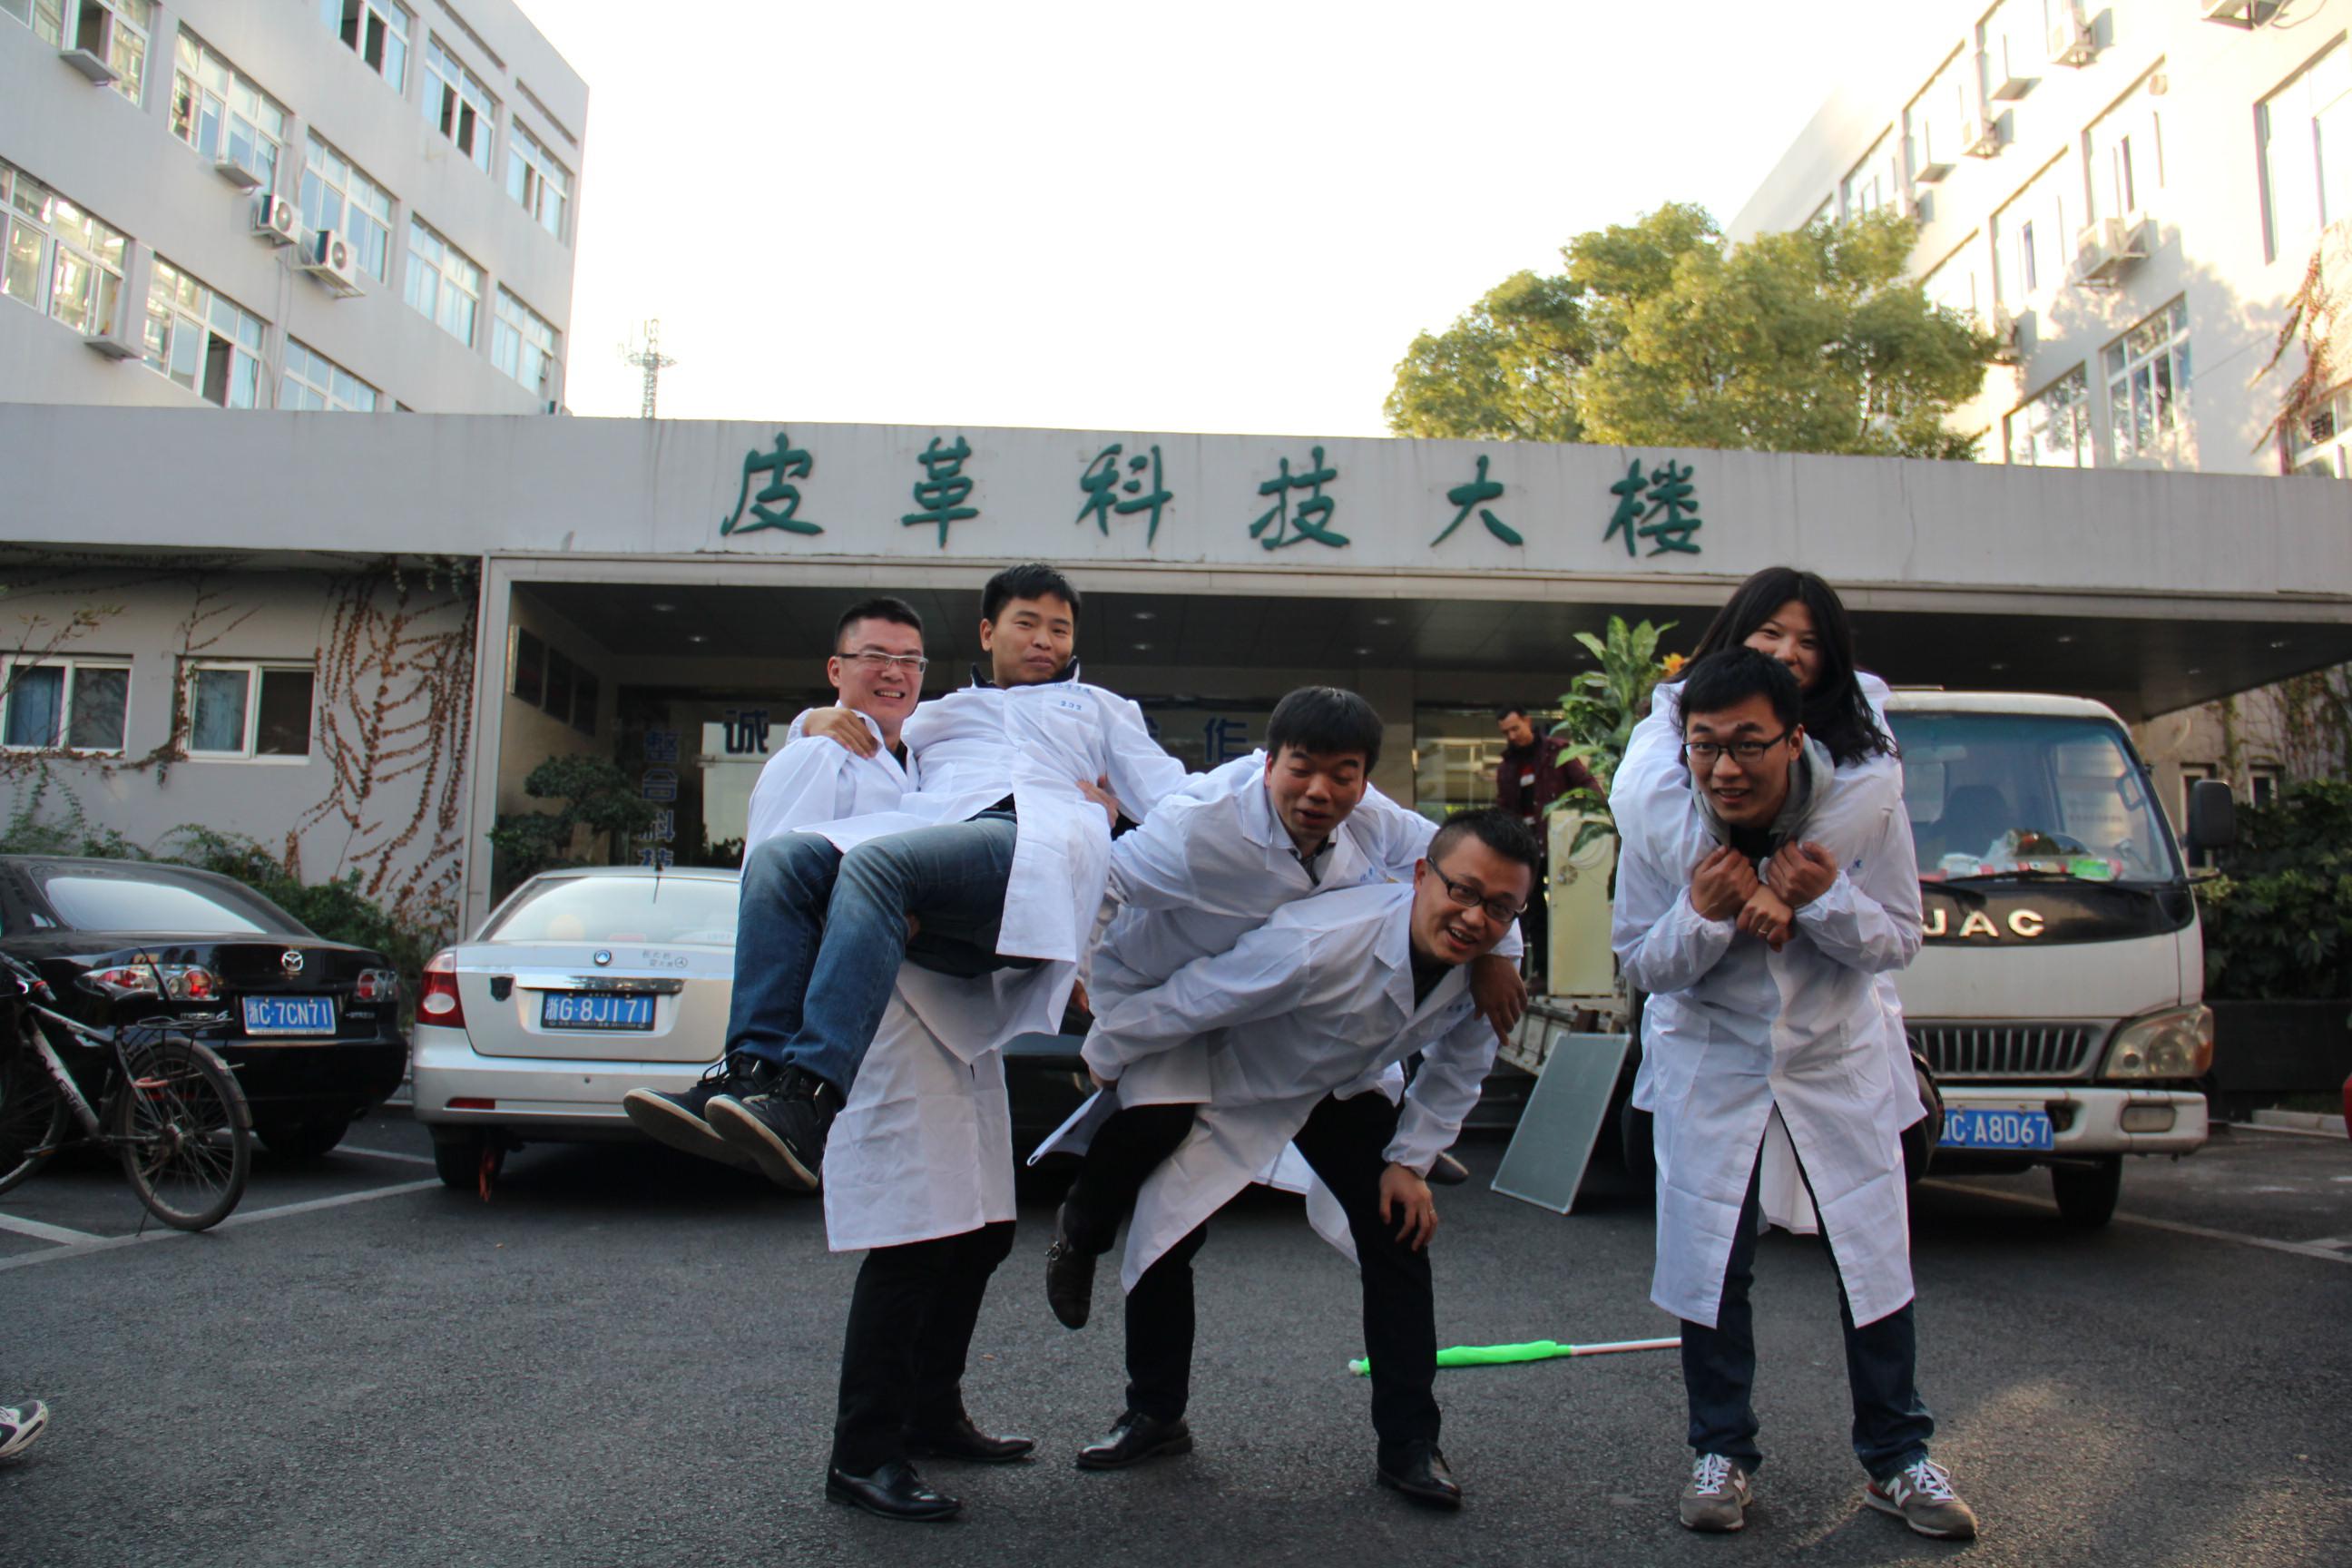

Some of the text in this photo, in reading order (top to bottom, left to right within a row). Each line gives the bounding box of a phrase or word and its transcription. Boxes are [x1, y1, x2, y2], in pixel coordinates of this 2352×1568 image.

[720, 432, 1702, 558] 皮革科技大楼
[1923, 908, 2044, 937] JAC
[1885, 1476, 1912, 1508] N
